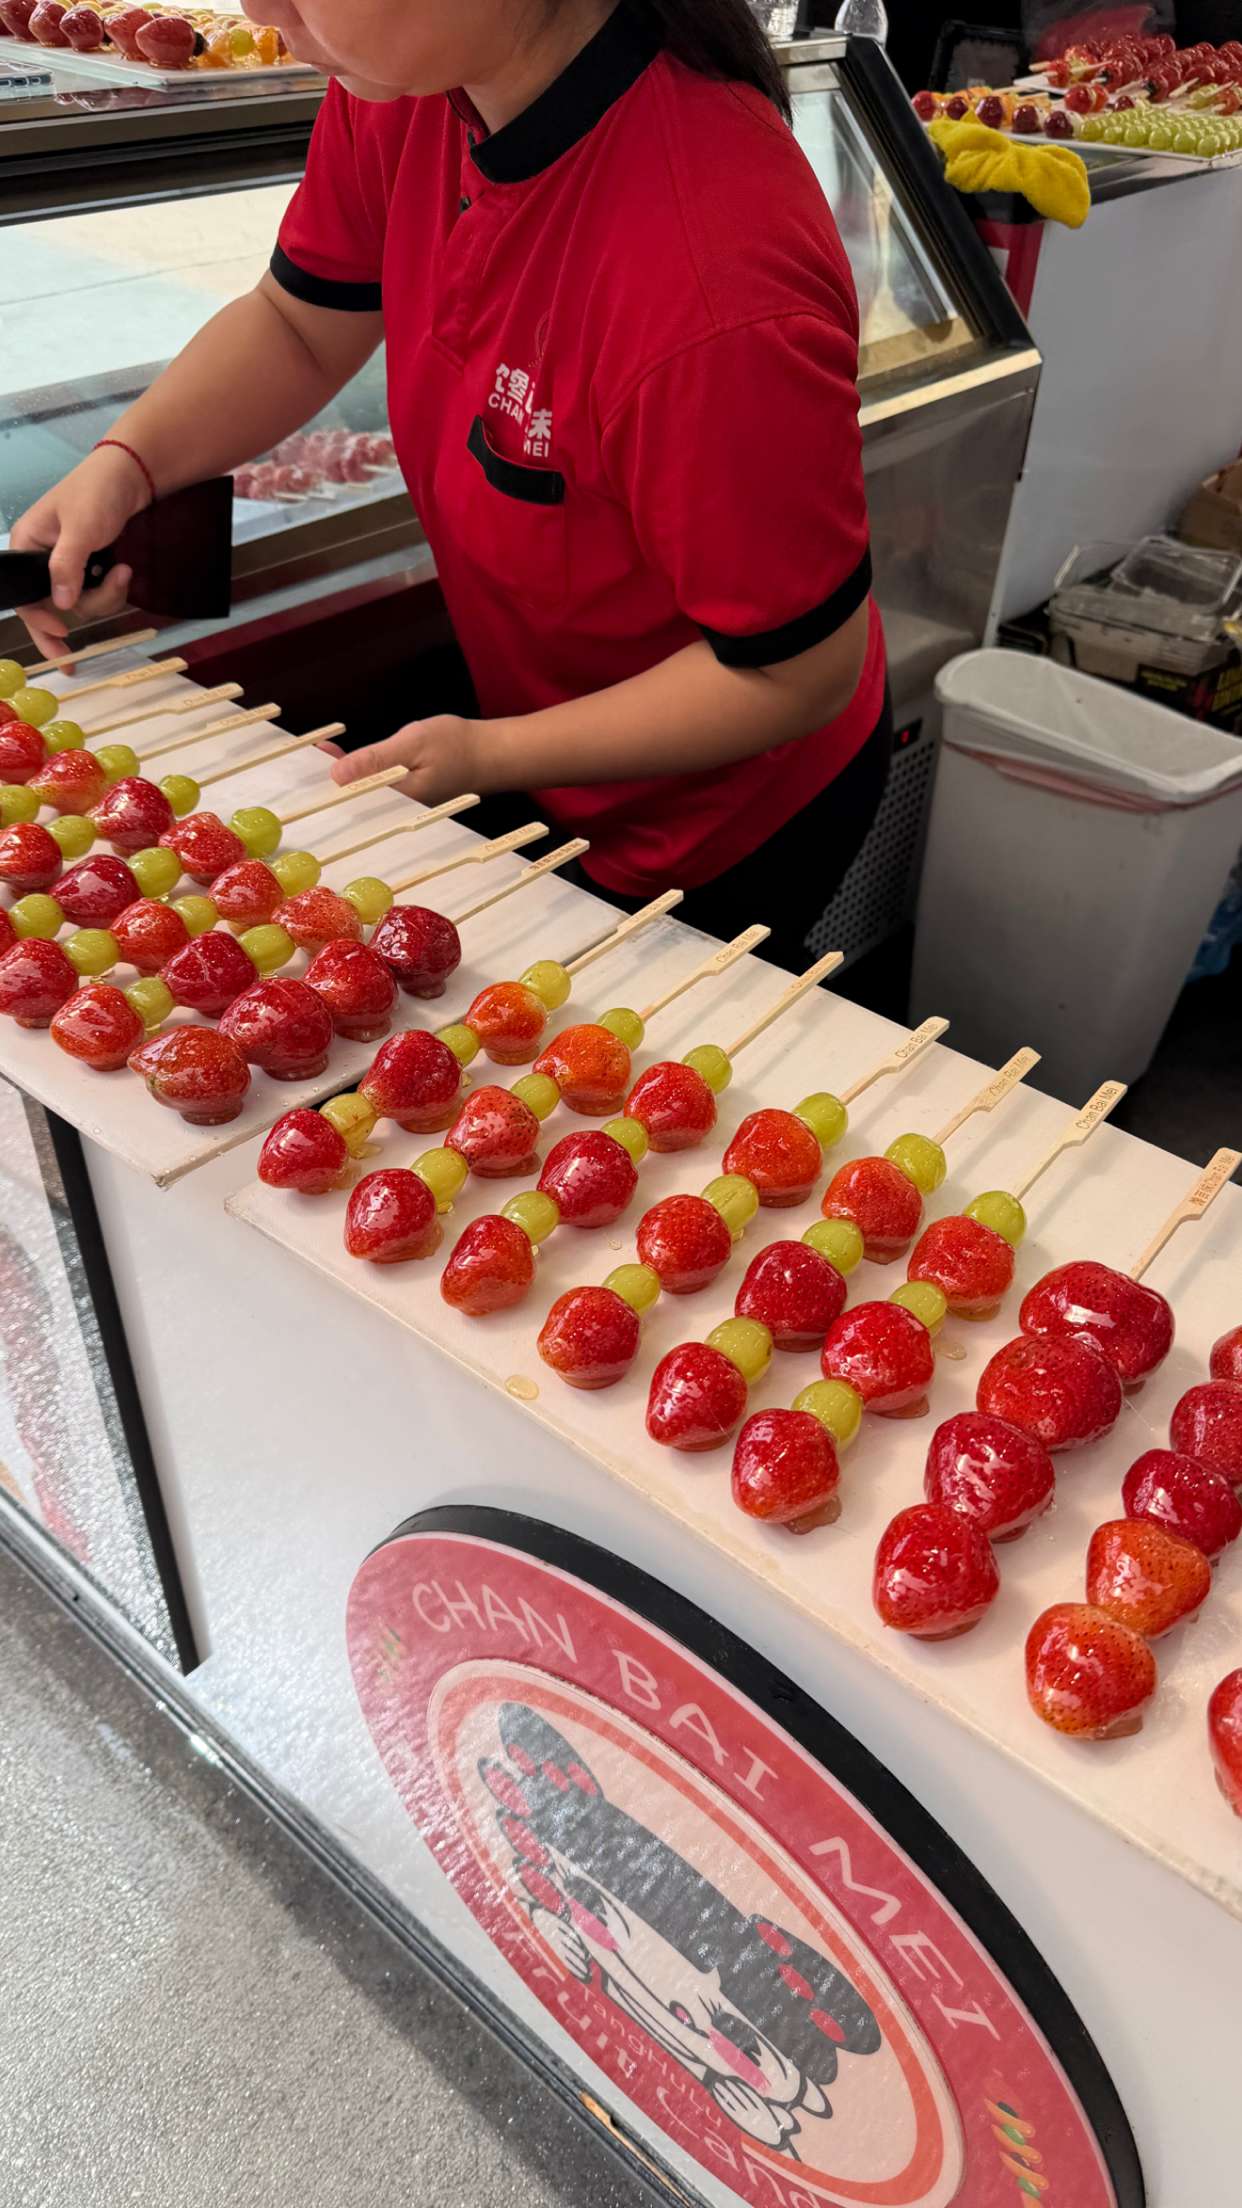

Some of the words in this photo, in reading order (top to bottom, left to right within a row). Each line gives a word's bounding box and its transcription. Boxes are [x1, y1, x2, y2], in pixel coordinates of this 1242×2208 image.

[411, 1579, 579, 1664] CHAN
[611, 1649, 779, 1803] BAI
[808, 1836, 1002, 2042] MEI
